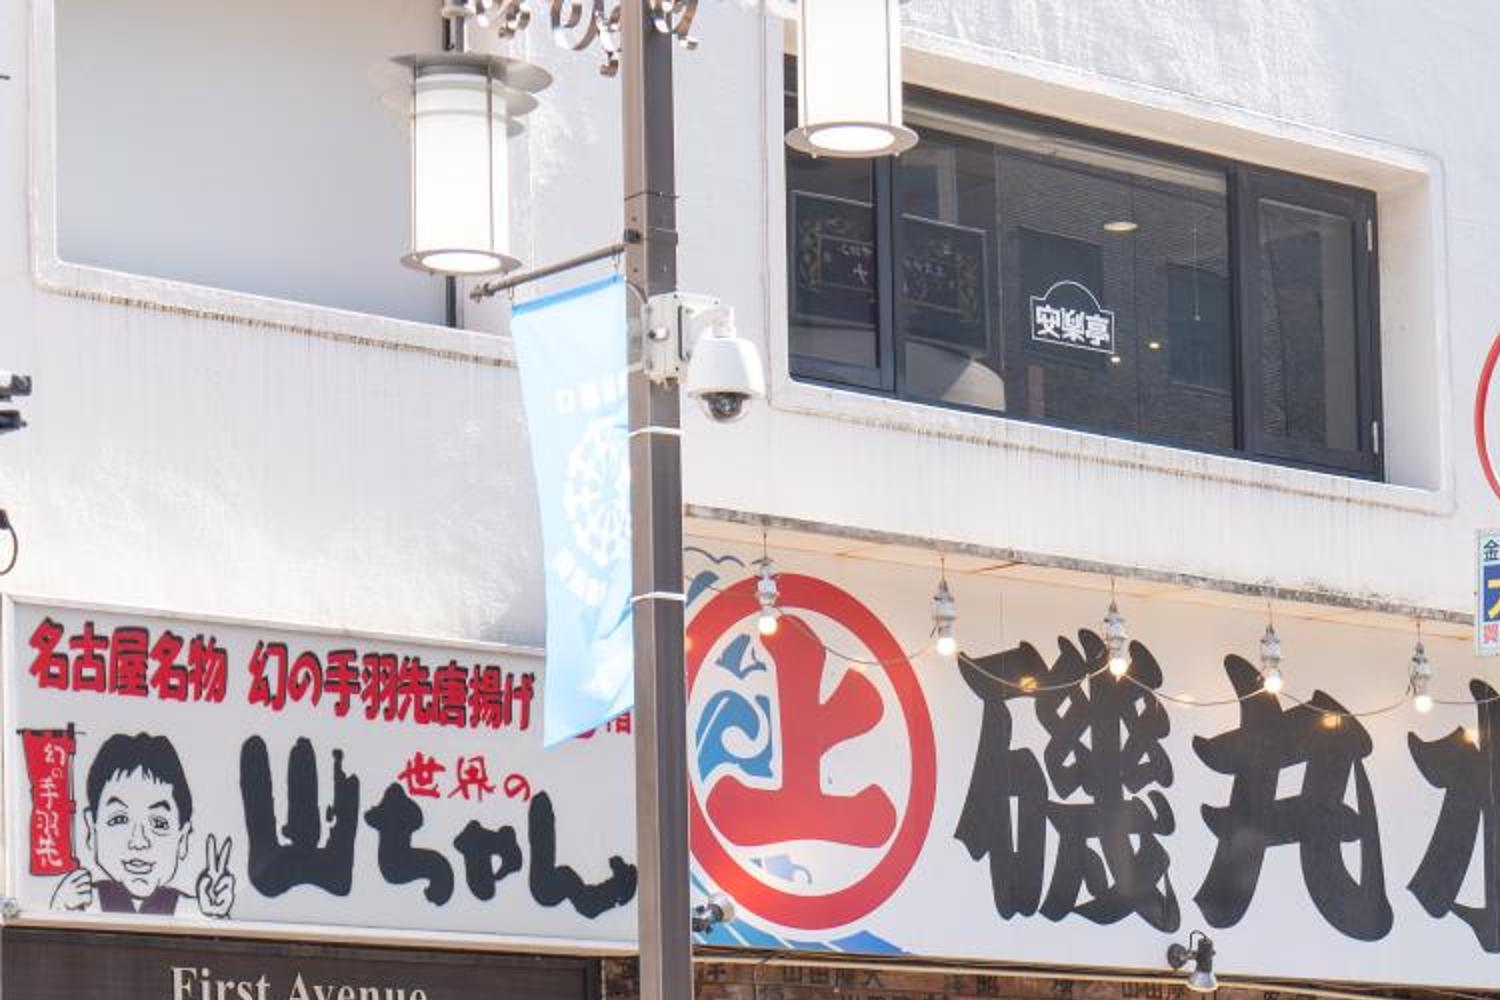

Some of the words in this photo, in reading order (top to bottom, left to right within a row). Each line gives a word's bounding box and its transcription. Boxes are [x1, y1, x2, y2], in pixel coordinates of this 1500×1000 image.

[28, 616, 228, 702] 名古屋名物
[248, 639, 535, 732] 幻の手羽先唐揚げ
[239, 734, 638, 920] 山ちゃん
[399, 749, 532, 801] 世界の
